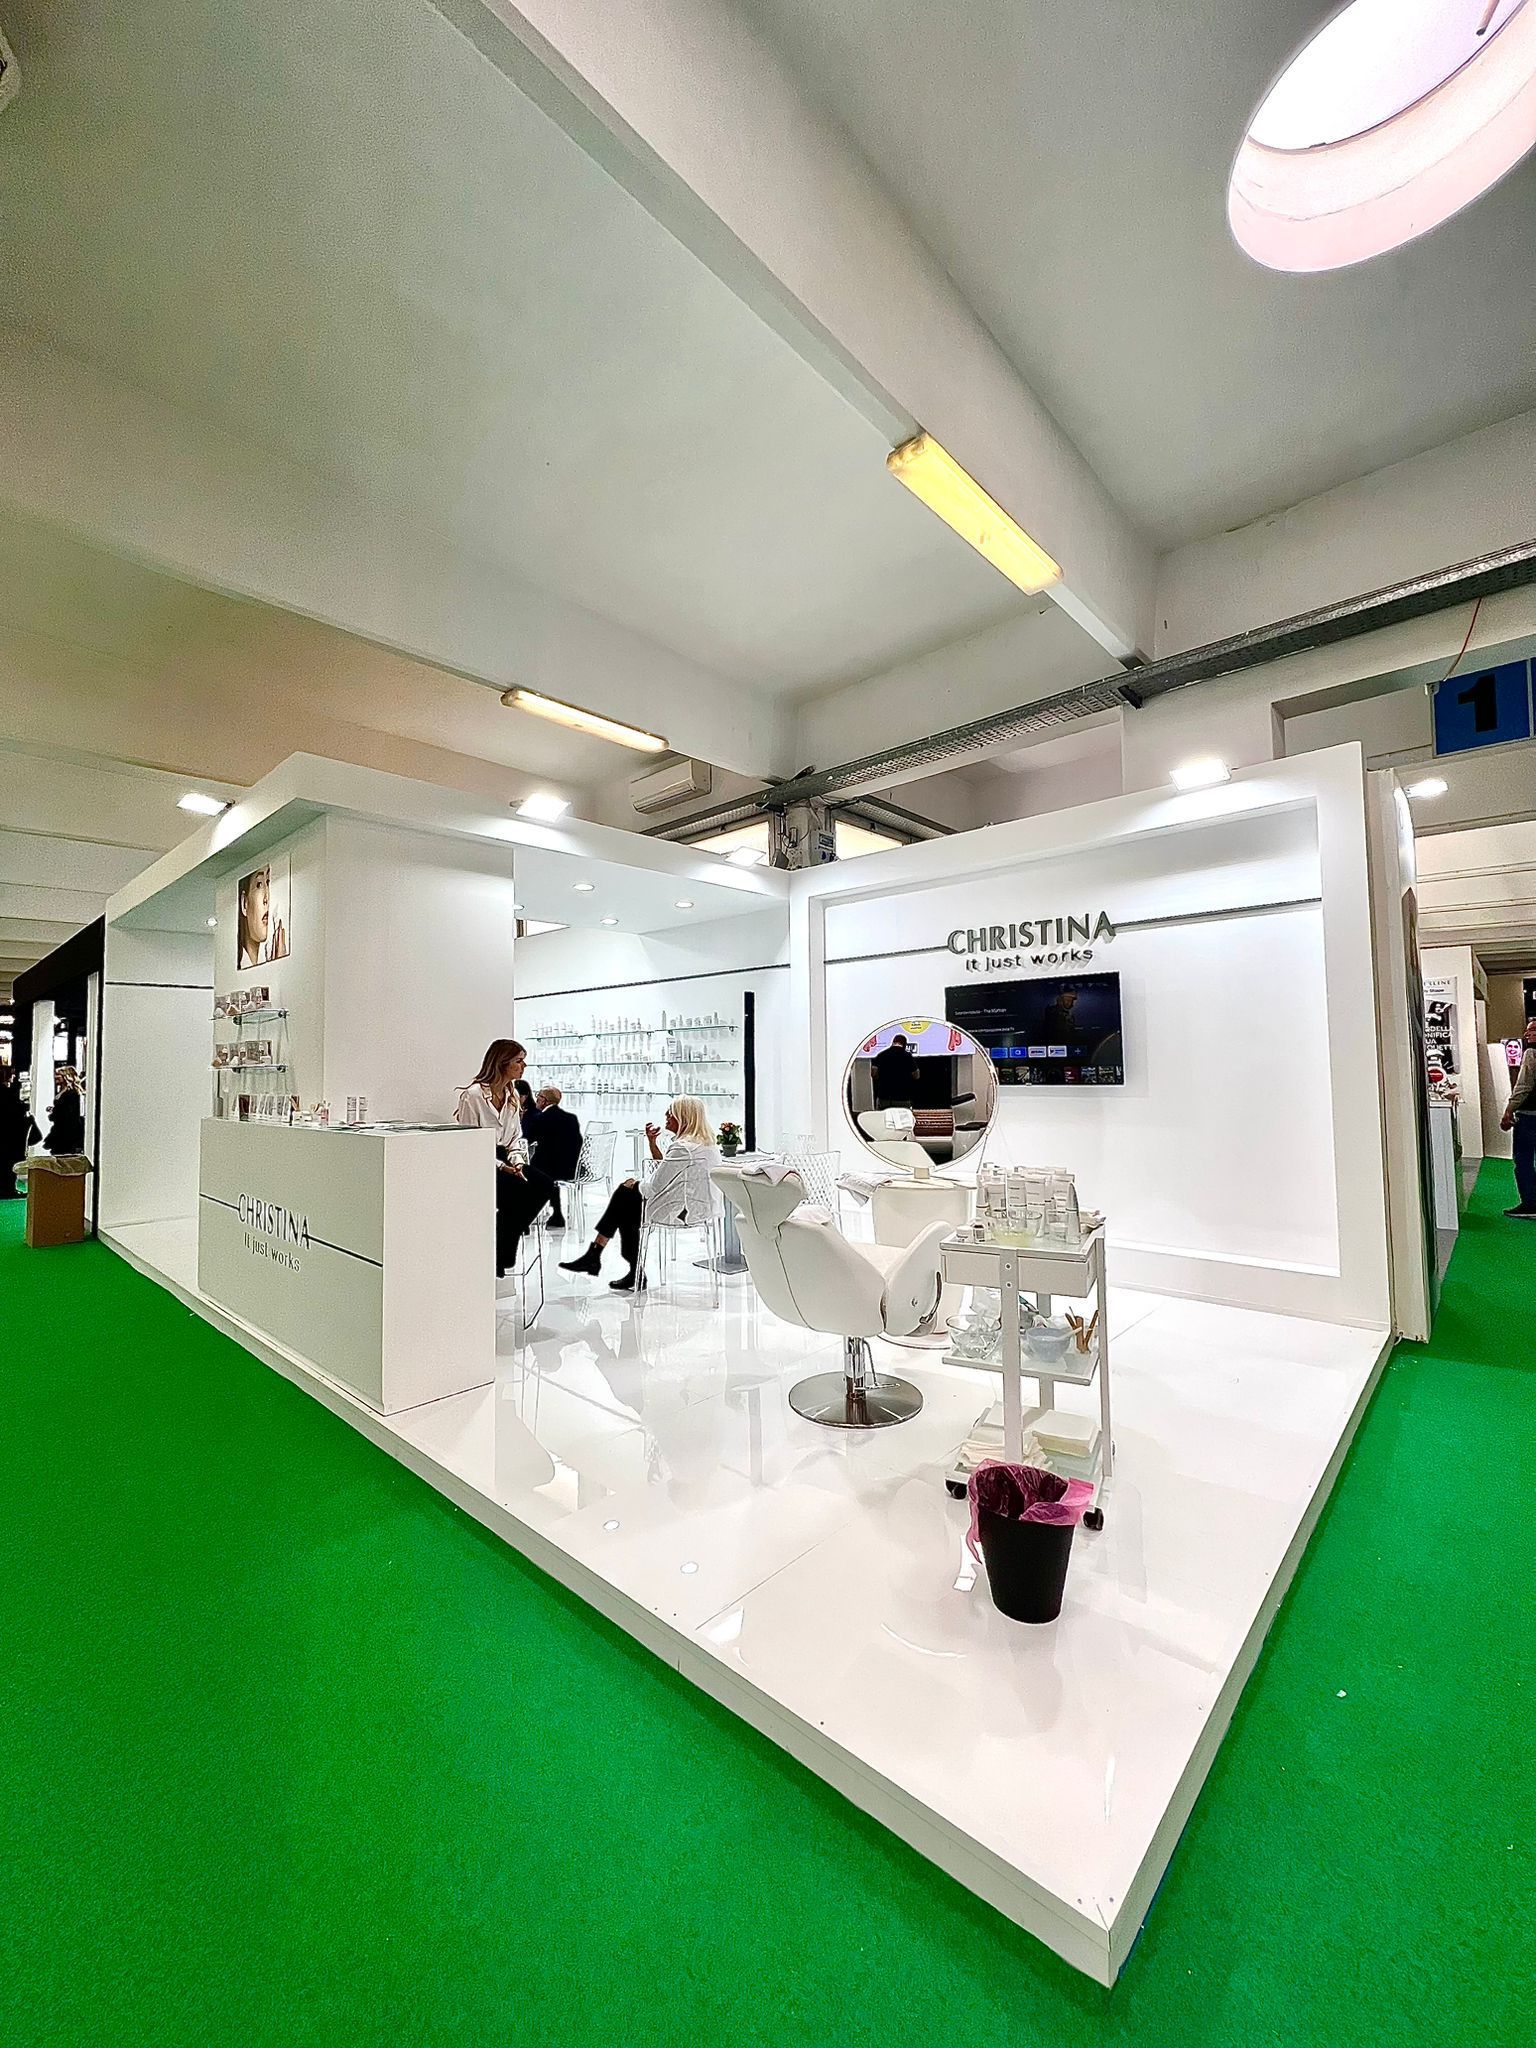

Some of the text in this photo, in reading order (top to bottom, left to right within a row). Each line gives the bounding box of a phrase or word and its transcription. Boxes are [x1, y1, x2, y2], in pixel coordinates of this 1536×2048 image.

[1457, 672, 1498, 733] 1
[947, 911, 1116, 955] CHRISTINA
[986, 954, 1022, 972] just
[1031, 948, 1093, 965] works
[239, 1193, 310, 1250] CHRISTINA
[252, 1236, 268, 1257] just
[271, 1248, 300, 1272] works
